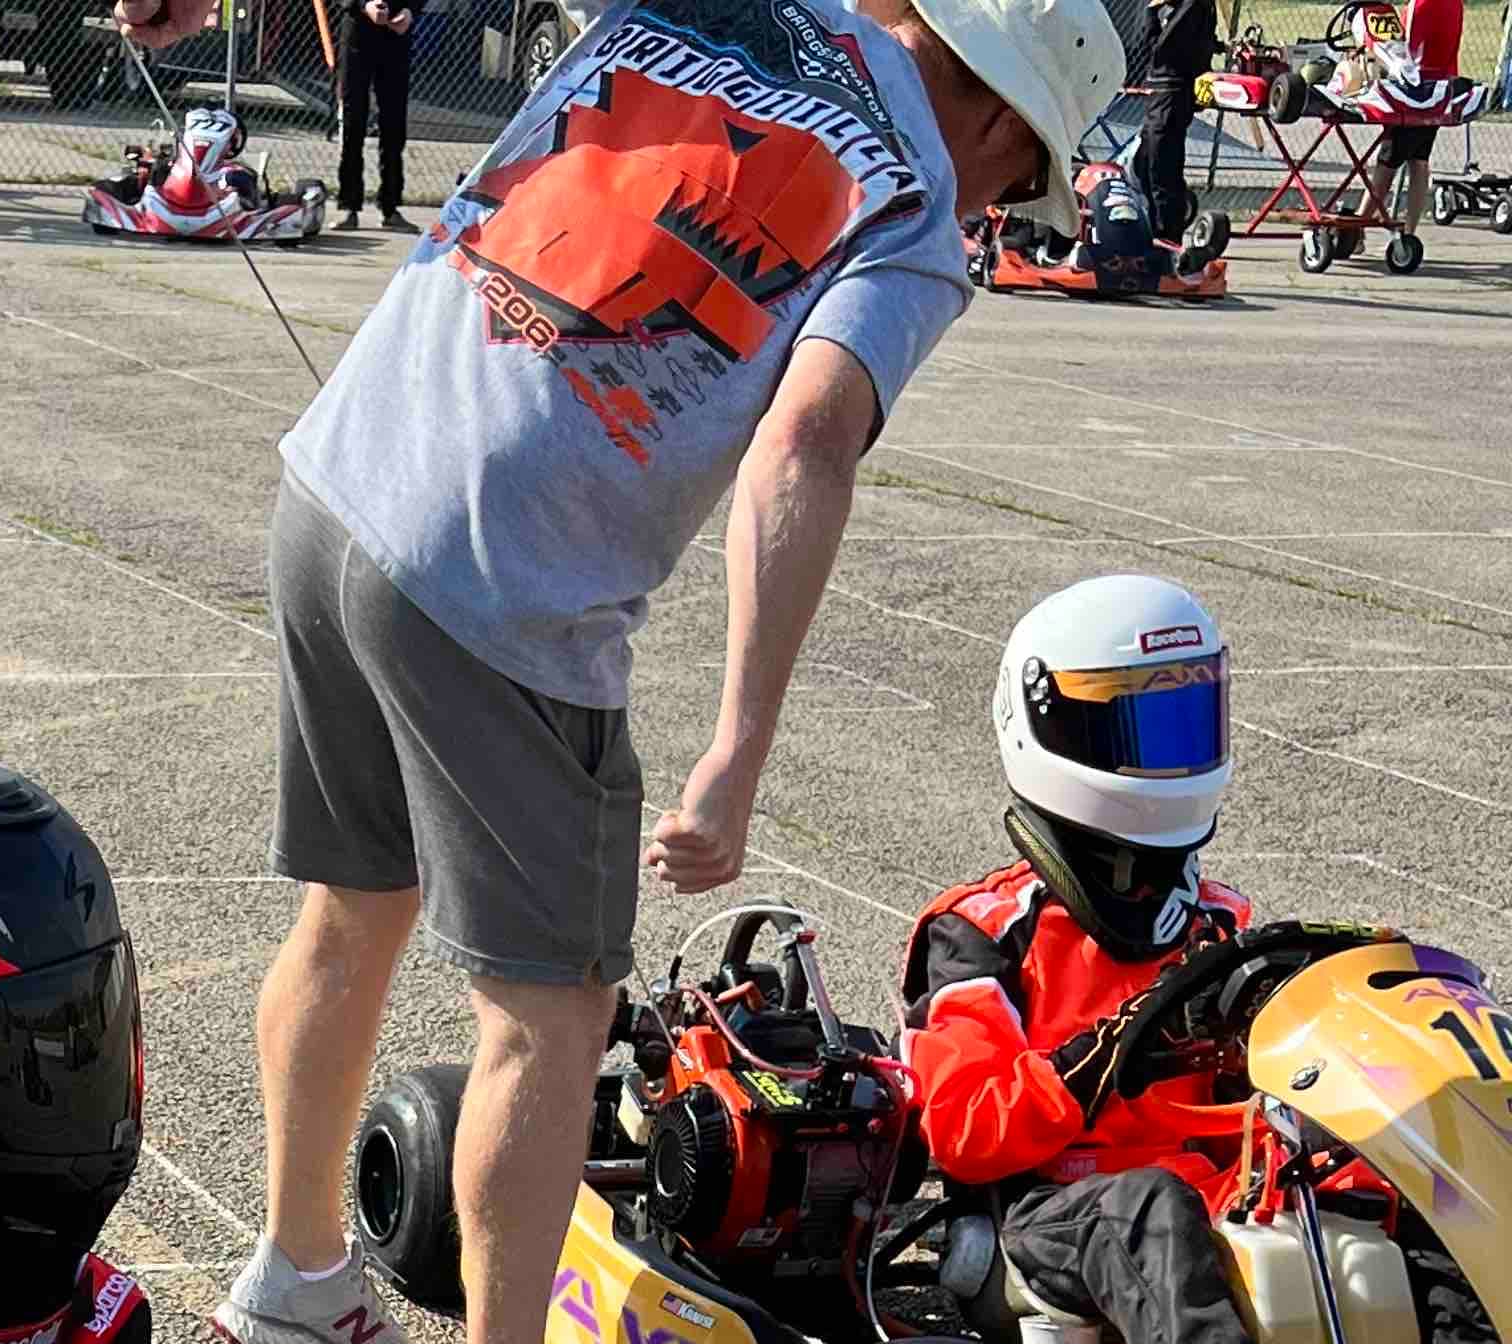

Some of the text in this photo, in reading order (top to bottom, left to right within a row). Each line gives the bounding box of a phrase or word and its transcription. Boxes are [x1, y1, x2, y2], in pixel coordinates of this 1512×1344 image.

[782, 6, 829, 57] BRIGGS
[833, 52, 887, 121] STRATTON
[481, 272, 558, 350] 206
[88, 1274, 135, 1337] sparco
